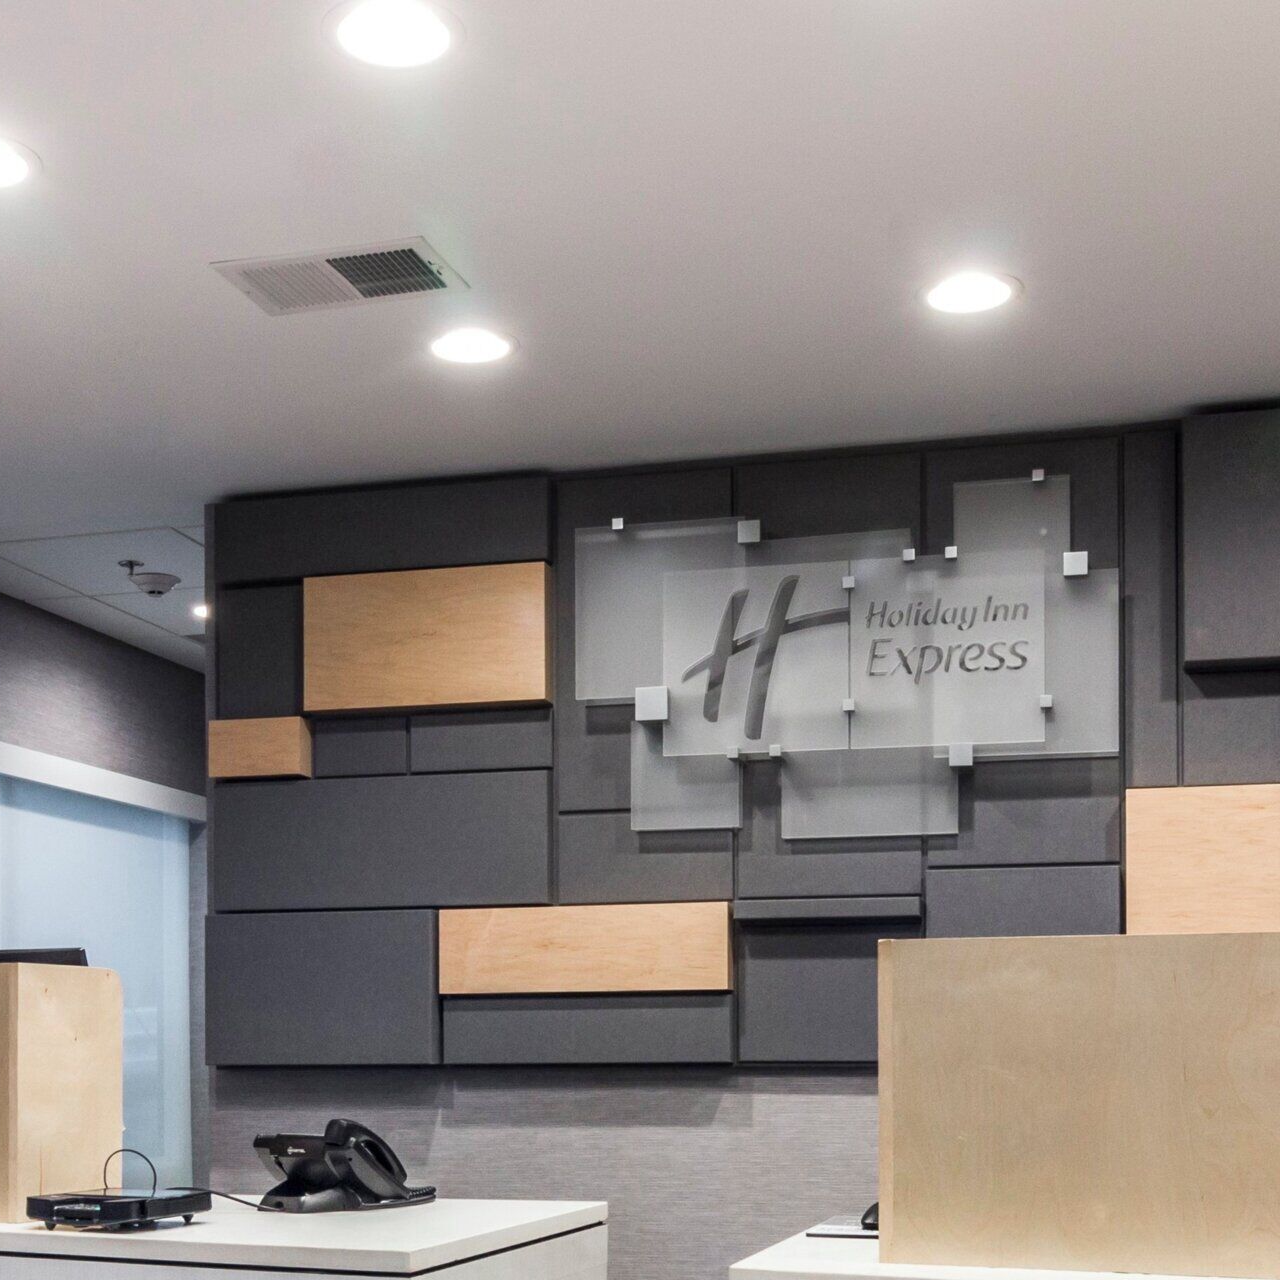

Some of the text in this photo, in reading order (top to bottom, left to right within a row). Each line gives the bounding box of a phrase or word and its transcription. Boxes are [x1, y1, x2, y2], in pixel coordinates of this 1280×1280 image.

[865, 596, 1029, 631] Holiday Inn
[866, 638, 1029, 685] Express
